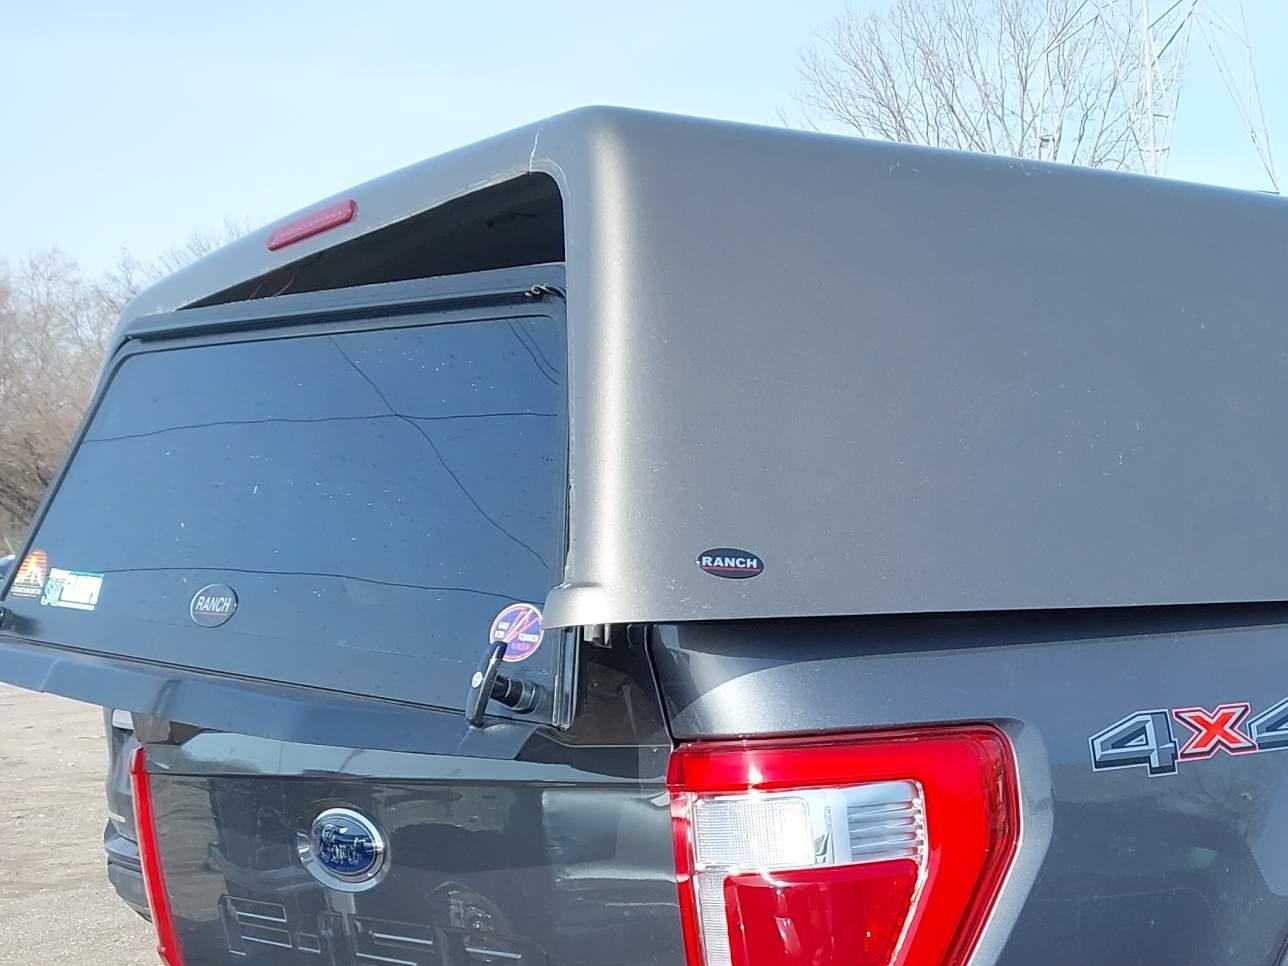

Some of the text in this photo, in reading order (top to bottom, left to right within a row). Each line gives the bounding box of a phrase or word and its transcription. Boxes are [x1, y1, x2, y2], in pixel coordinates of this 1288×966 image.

[701, 555, 758, 569] RANCH
[194, 594, 233, 613] RANCH
[319, 823, 369, 865] Ford
